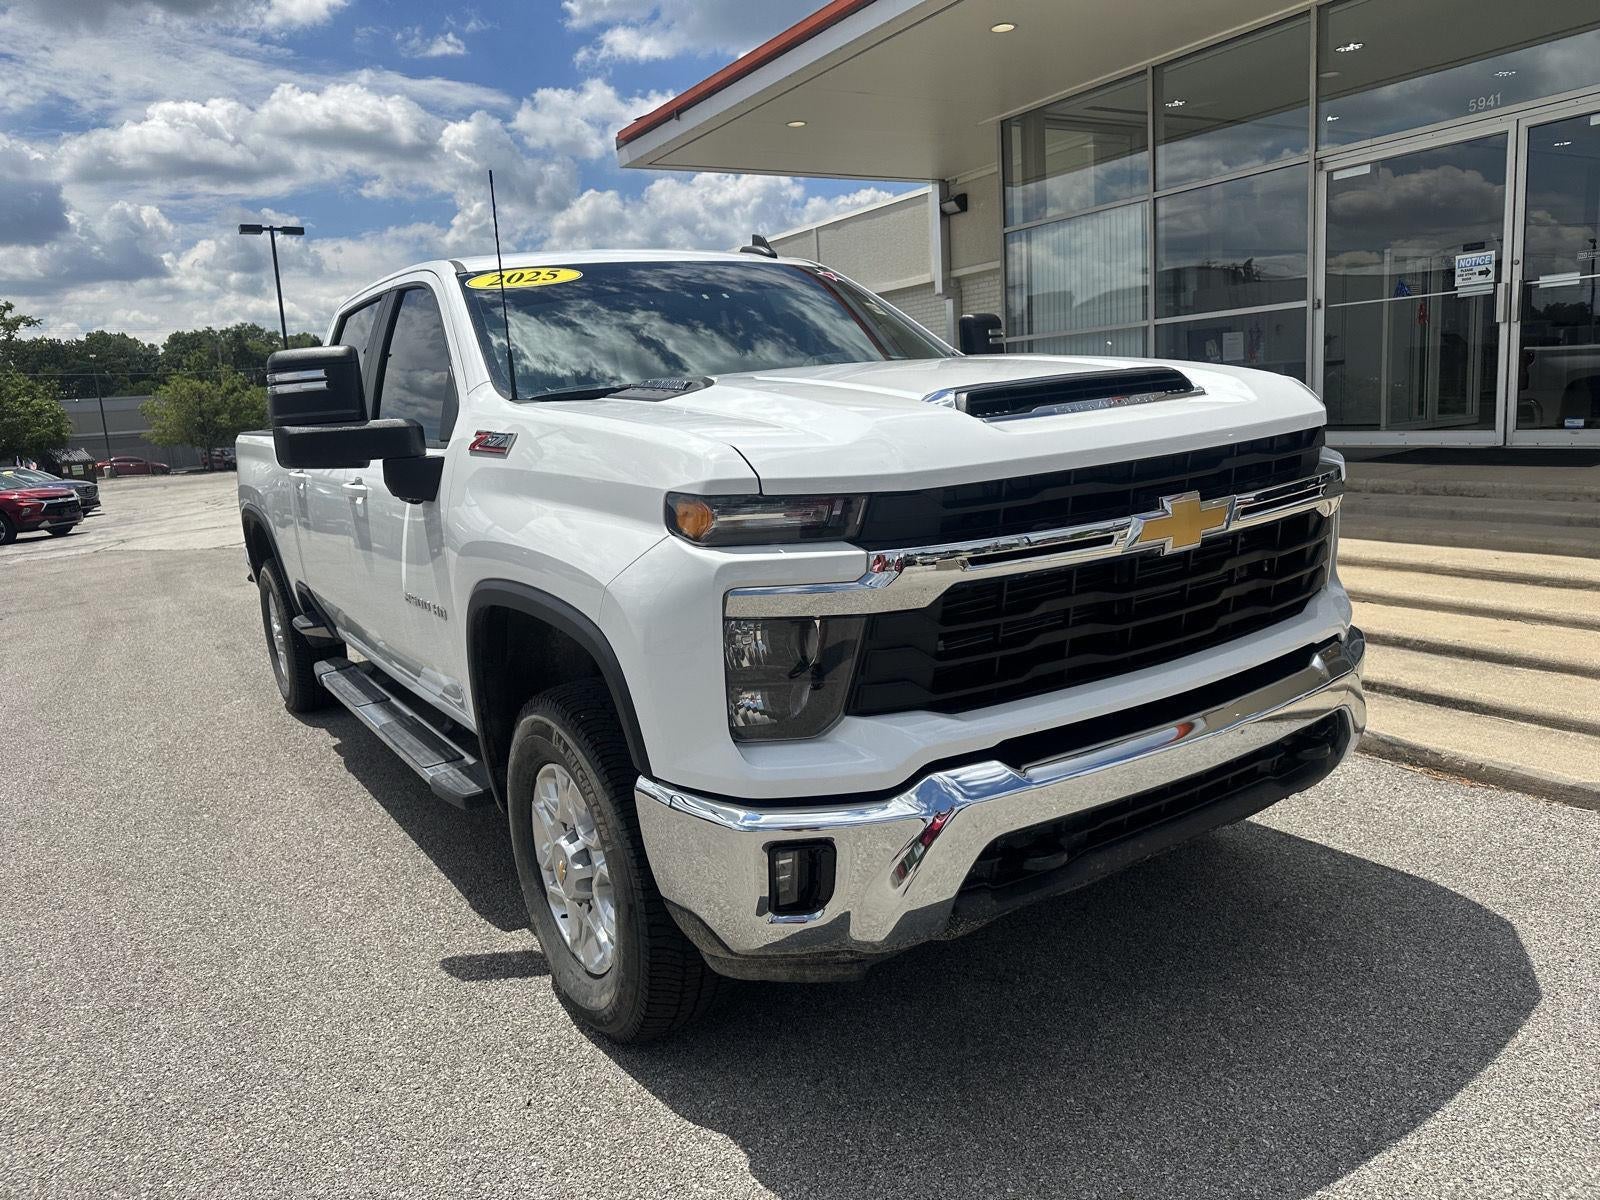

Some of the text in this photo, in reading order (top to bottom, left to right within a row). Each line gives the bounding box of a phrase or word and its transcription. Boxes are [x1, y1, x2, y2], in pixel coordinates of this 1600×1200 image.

[1468, 92, 1502, 112] 5941
[1459, 255, 1491, 268] NOTICE
[486, 269, 561, 287] 2025
[565, 750, 611, 842] MICHELIN
